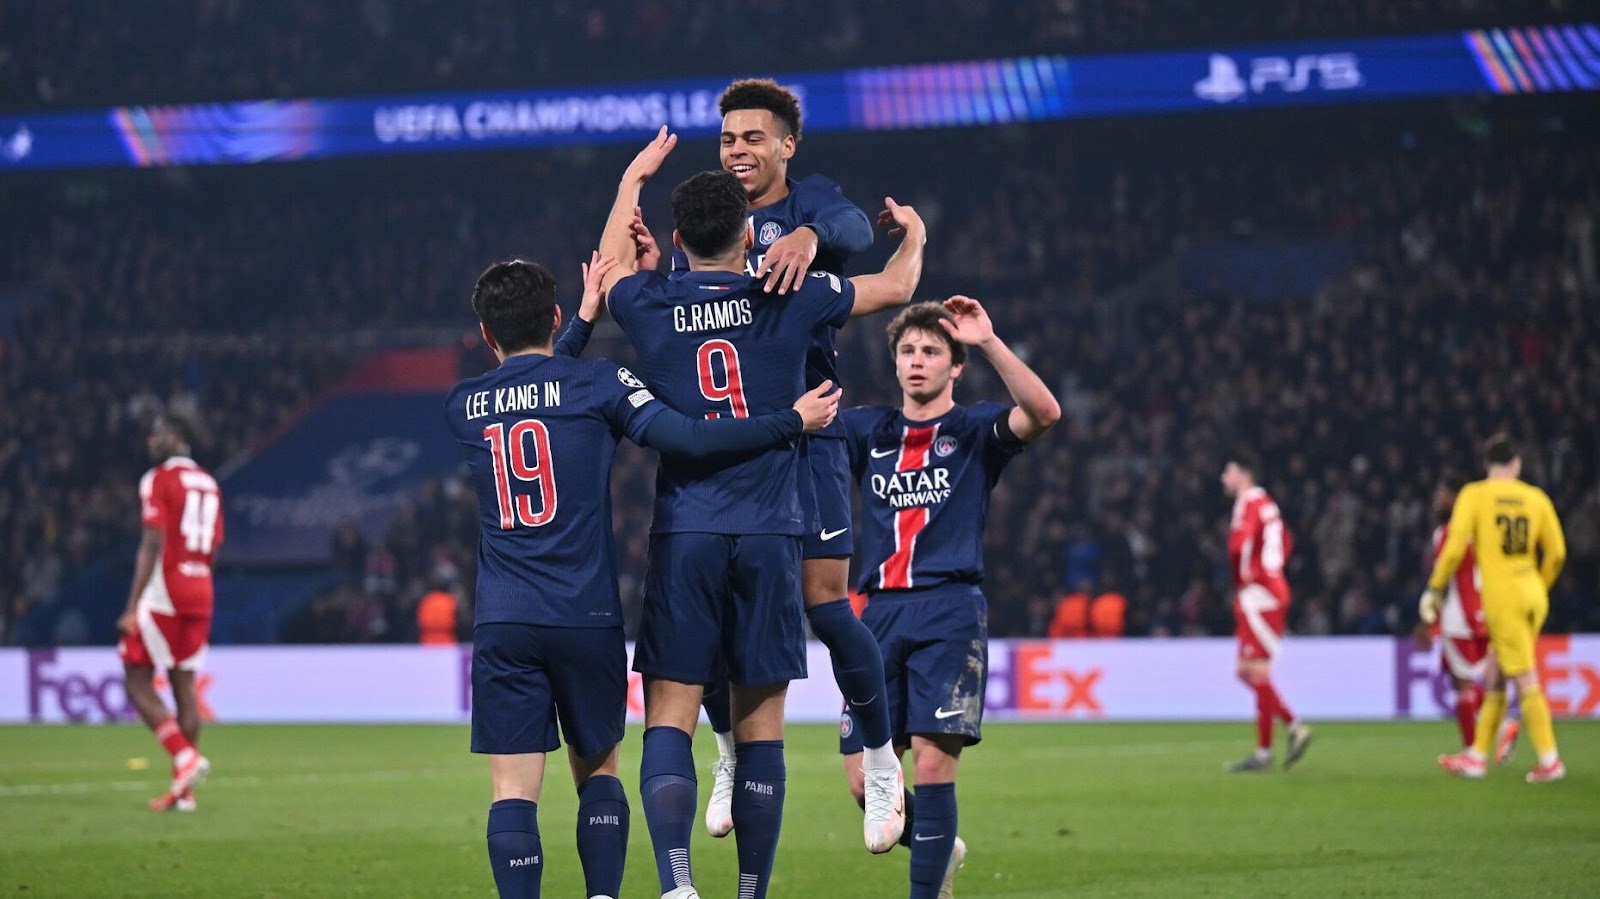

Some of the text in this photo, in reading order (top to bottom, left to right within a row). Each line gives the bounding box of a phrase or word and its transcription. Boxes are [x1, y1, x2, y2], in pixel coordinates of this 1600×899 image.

[1250, 53, 1361, 94] PS5
[373, 104, 460, 143] UEFA
[464, 92, 669, 139] CHAMPIONS
[674, 298, 753, 332] G.RAMOS
[697, 339, 749, 419] 9
[466, 381, 560, 420] LEE KANG IN
[483, 419, 557, 530] 19
[871, 468, 951, 499] QATAR
[890, 489, 951, 507] AIRWAYS
[744, 780, 773, 795] PARIS
[589, 815, 619, 826] PARIS
[509, 856, 539, 867] PARIS
